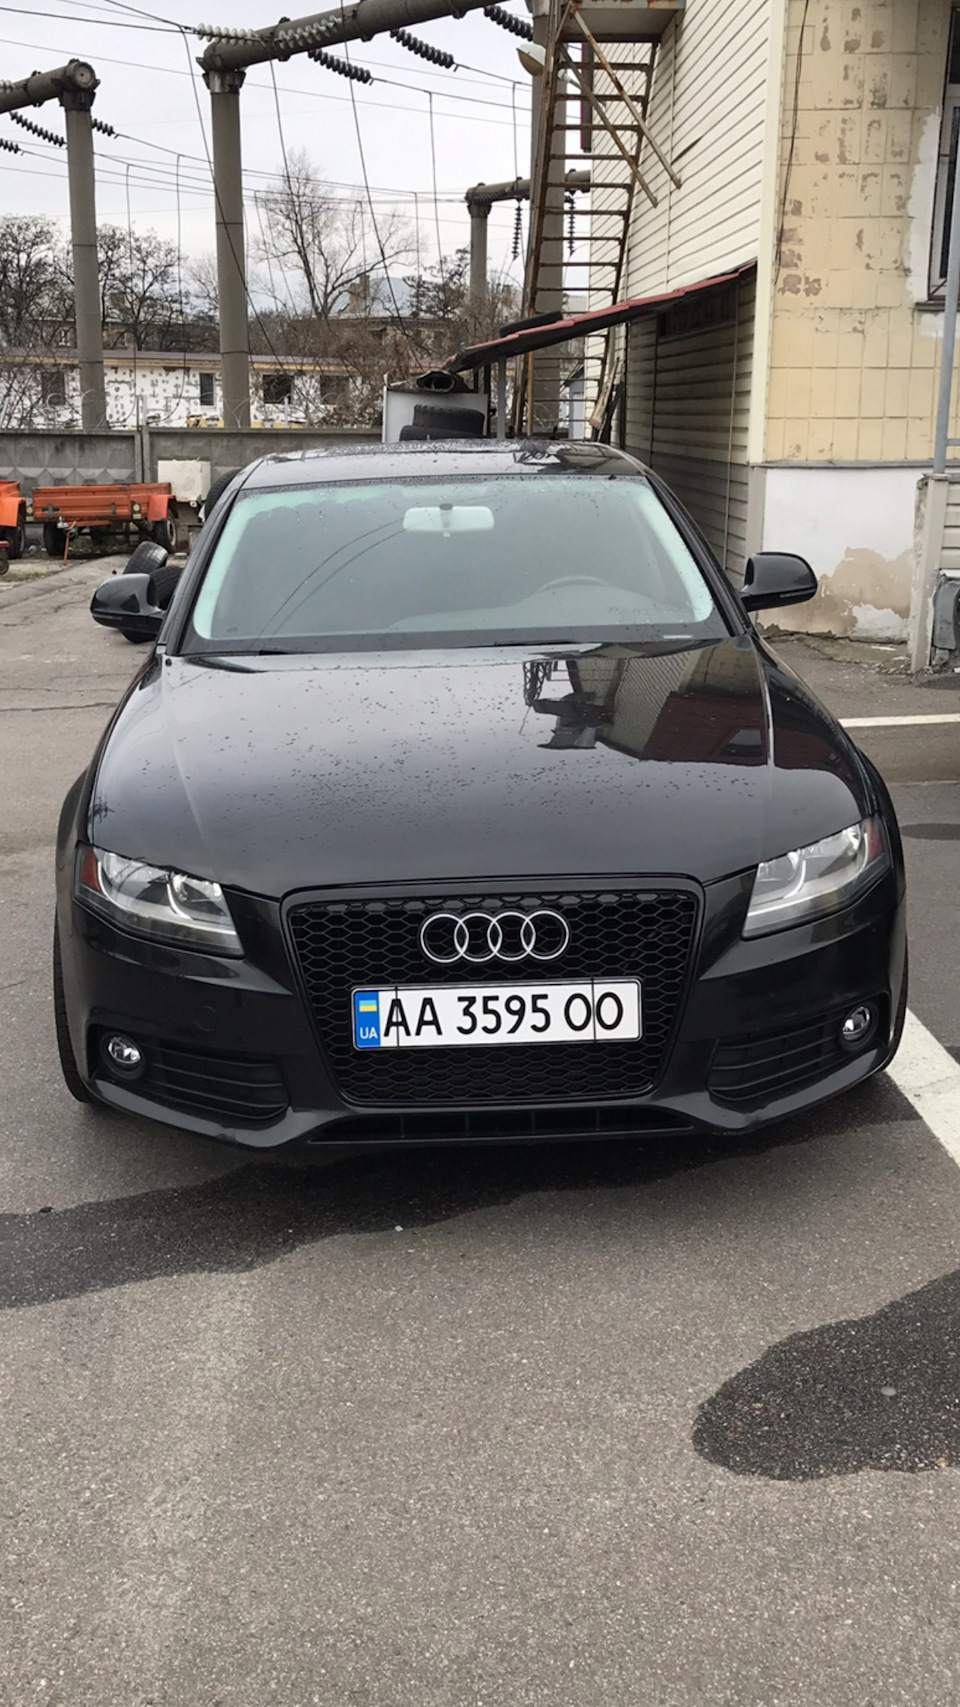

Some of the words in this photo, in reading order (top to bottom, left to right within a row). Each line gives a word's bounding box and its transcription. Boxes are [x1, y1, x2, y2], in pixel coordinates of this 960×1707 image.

[383, 997, 443, 1037] AA
[456, 993, 551, 1035] 3595
[359, 1027, 378, 1040] UA
